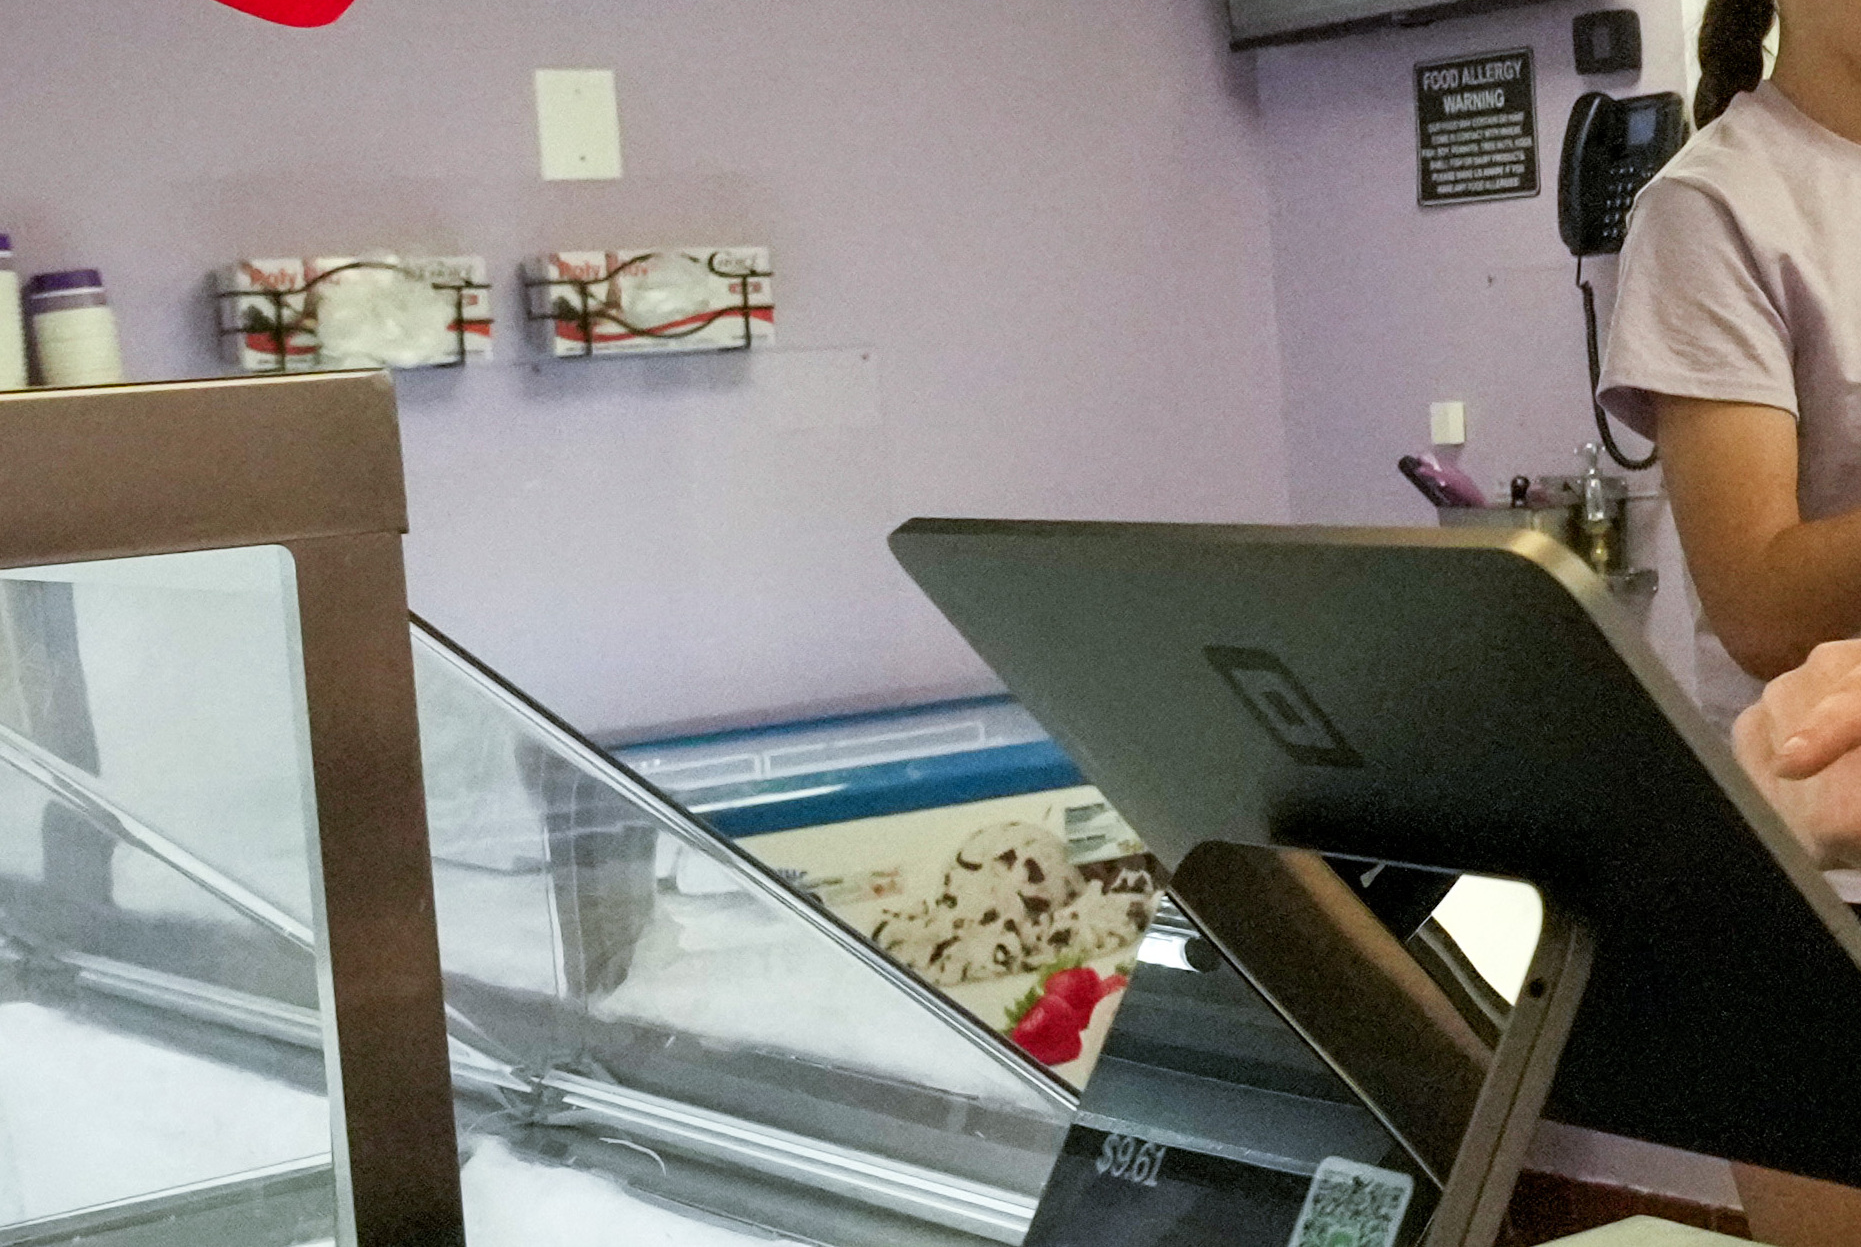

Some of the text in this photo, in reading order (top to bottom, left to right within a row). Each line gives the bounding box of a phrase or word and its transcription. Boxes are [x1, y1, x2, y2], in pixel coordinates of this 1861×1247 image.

[1422, 60, 1523, 91] FOOD ALLERGY
[1443, 89, 1505, 114] WARNING
